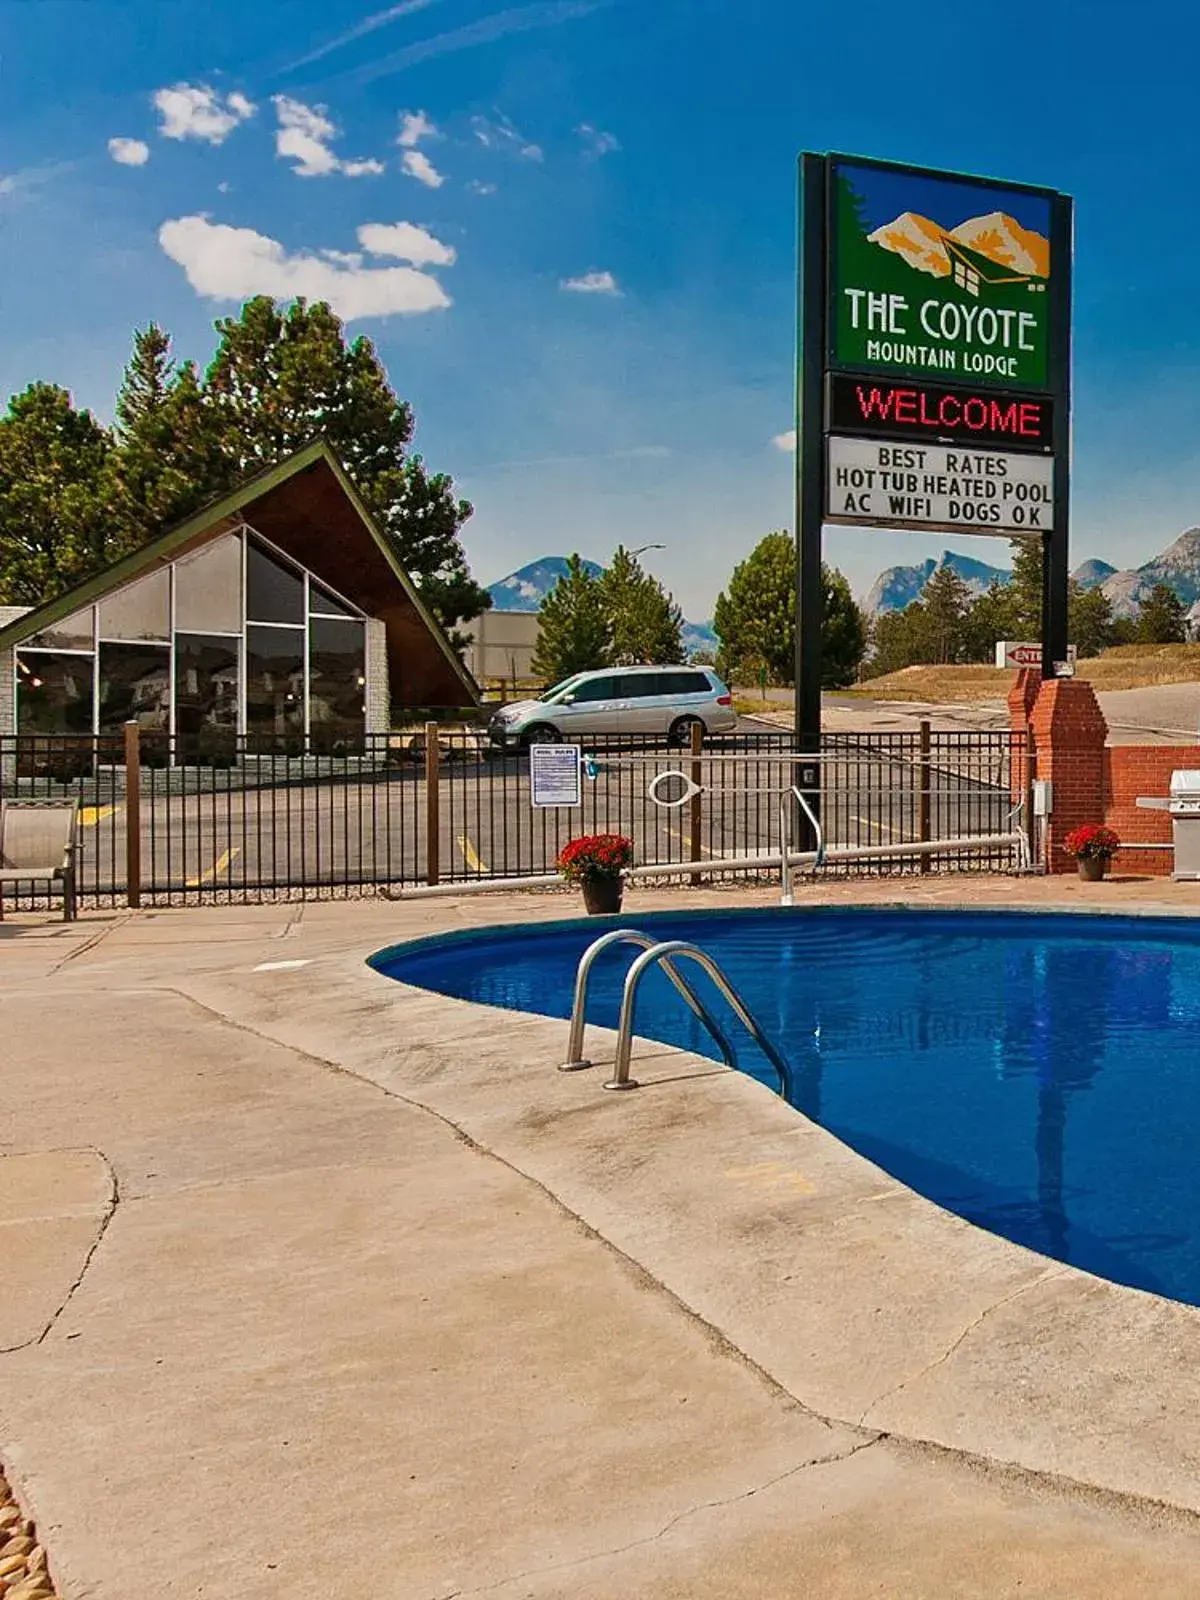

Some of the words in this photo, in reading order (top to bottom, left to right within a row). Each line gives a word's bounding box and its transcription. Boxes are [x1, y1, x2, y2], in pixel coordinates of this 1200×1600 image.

[844, 288, 909, 335] THE
[920, 300, 1038, 351] COYOTE
[867, 340, 956, 369] MOUNTAIN
[963, 352, 1018, 377] LODGE
[855, 385, 1041, 437] WELCOME
[879, 448, 927, 469] BEST
[947, 453, 1008, 477] RATES
[923, 475, 996, 499] HEATED
[1003, 482, 1051, 504] POOL
[844, 492, 872, 513] AC
[889, 496, 931, 517] WIFI
[949, 501, 1000, 522] DOGS
